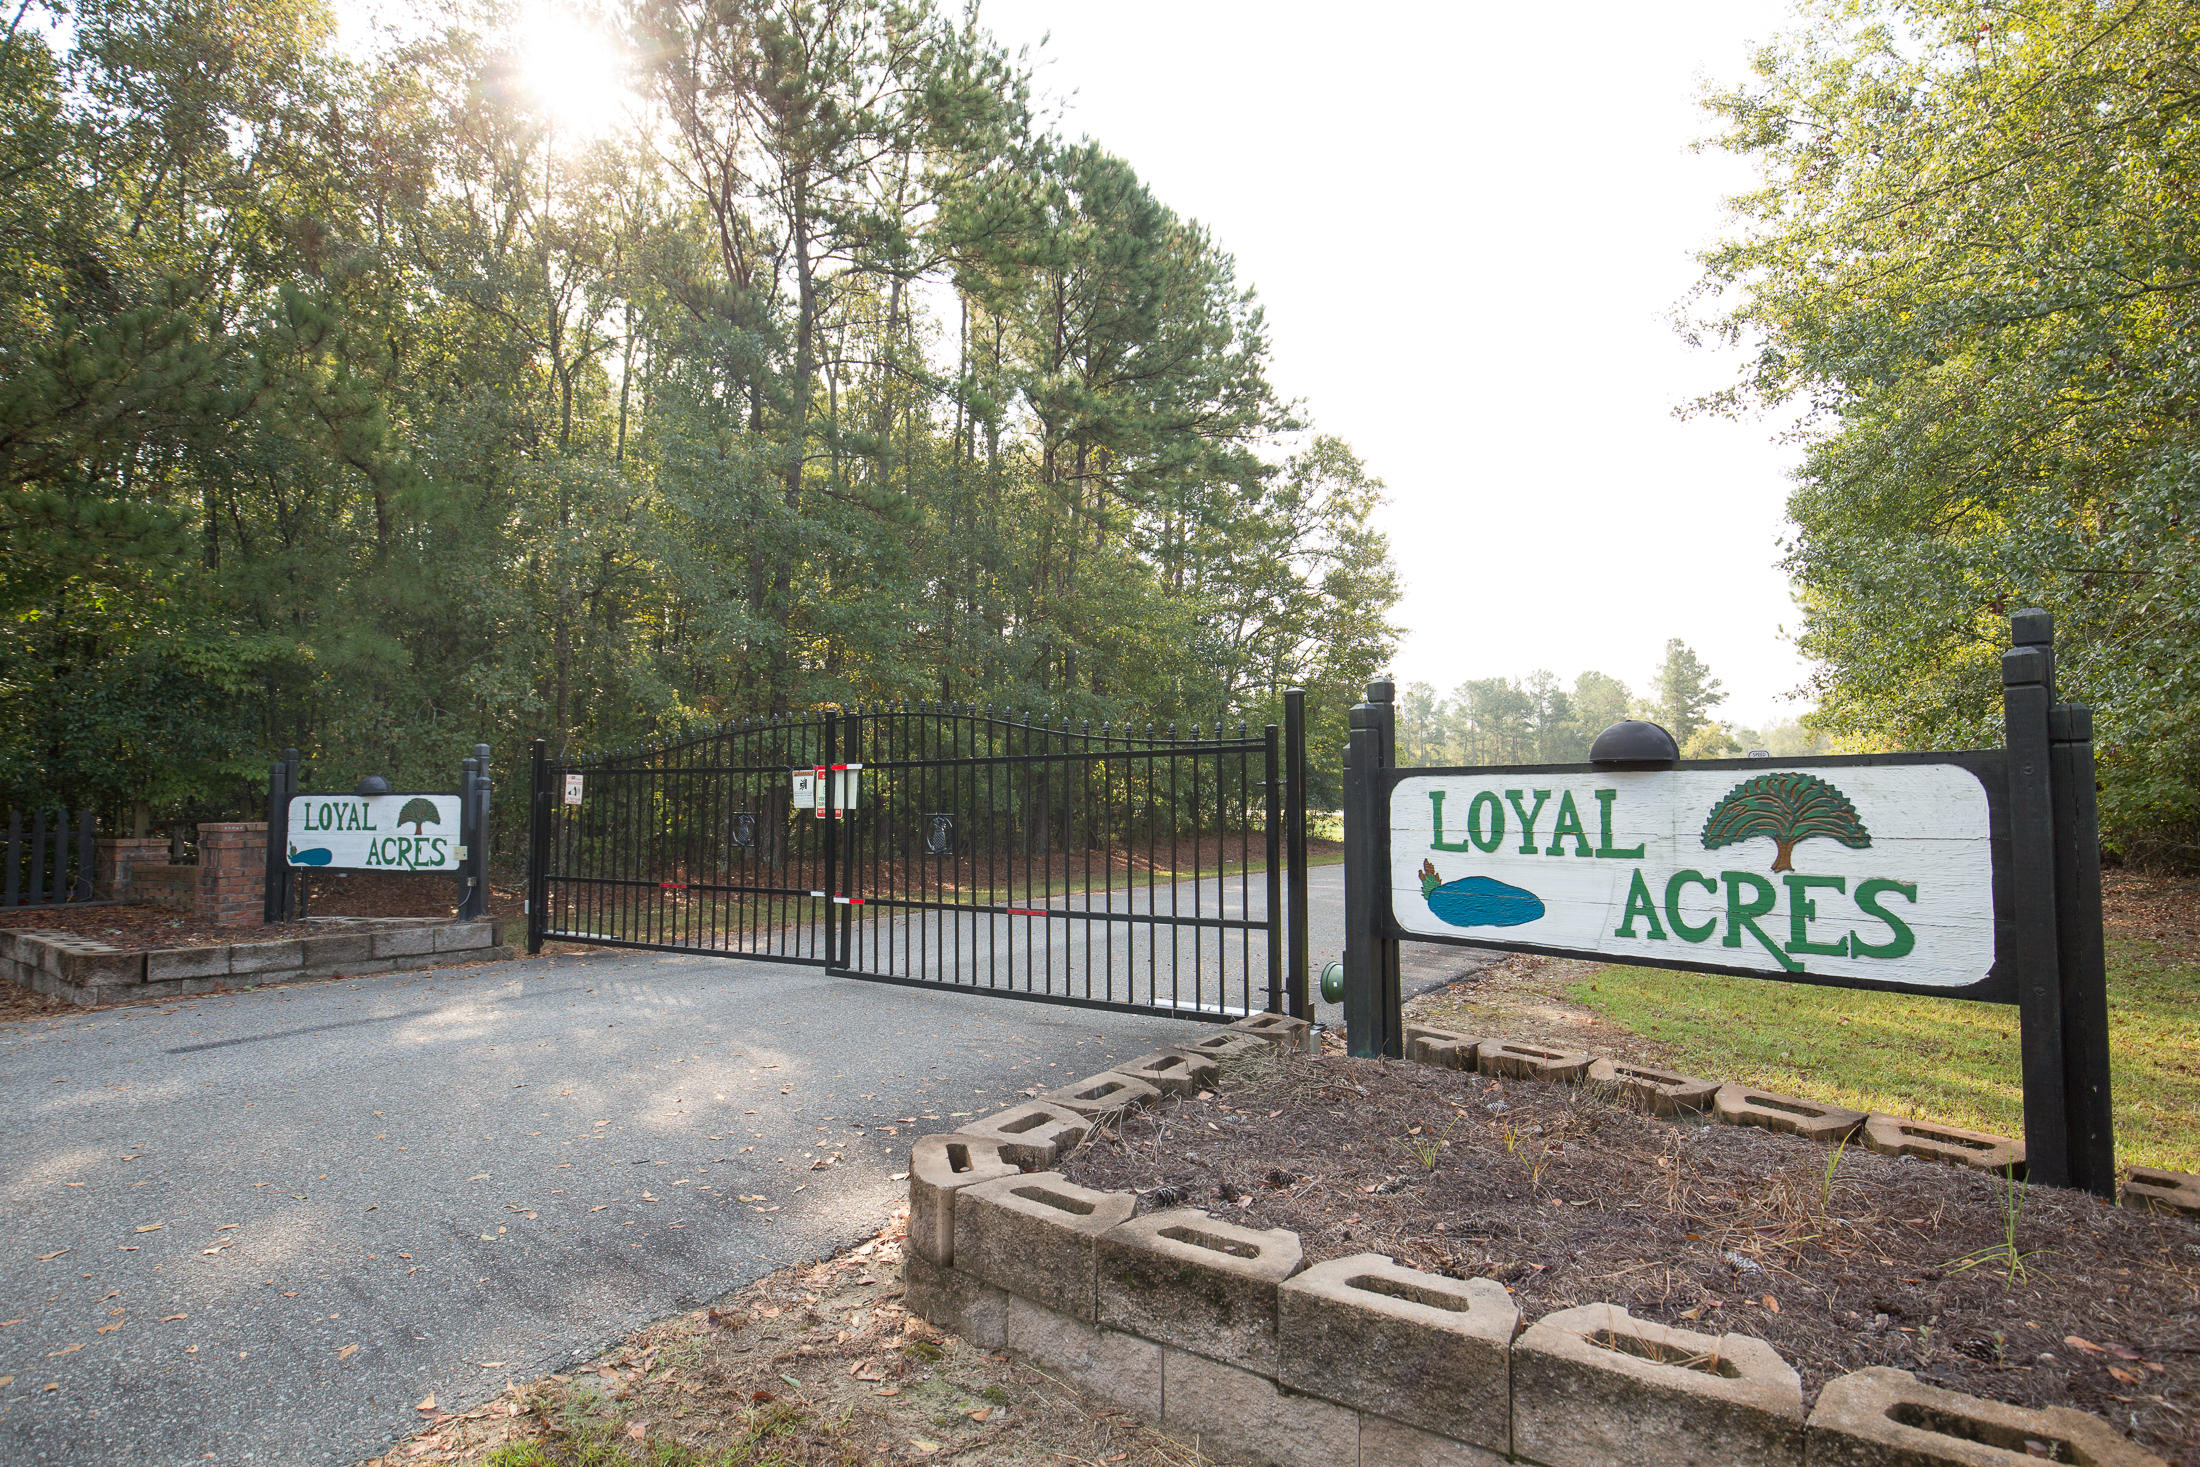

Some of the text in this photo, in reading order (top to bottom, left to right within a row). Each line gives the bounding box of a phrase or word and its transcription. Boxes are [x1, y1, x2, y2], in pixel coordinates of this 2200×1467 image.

[303, 801, 377, 831] LOYAL
[1428, 788, 1646, 859] LOYAL
[365, 836, 448, 871] ACRES
[1615, 868, 1918, 973] ACRES
